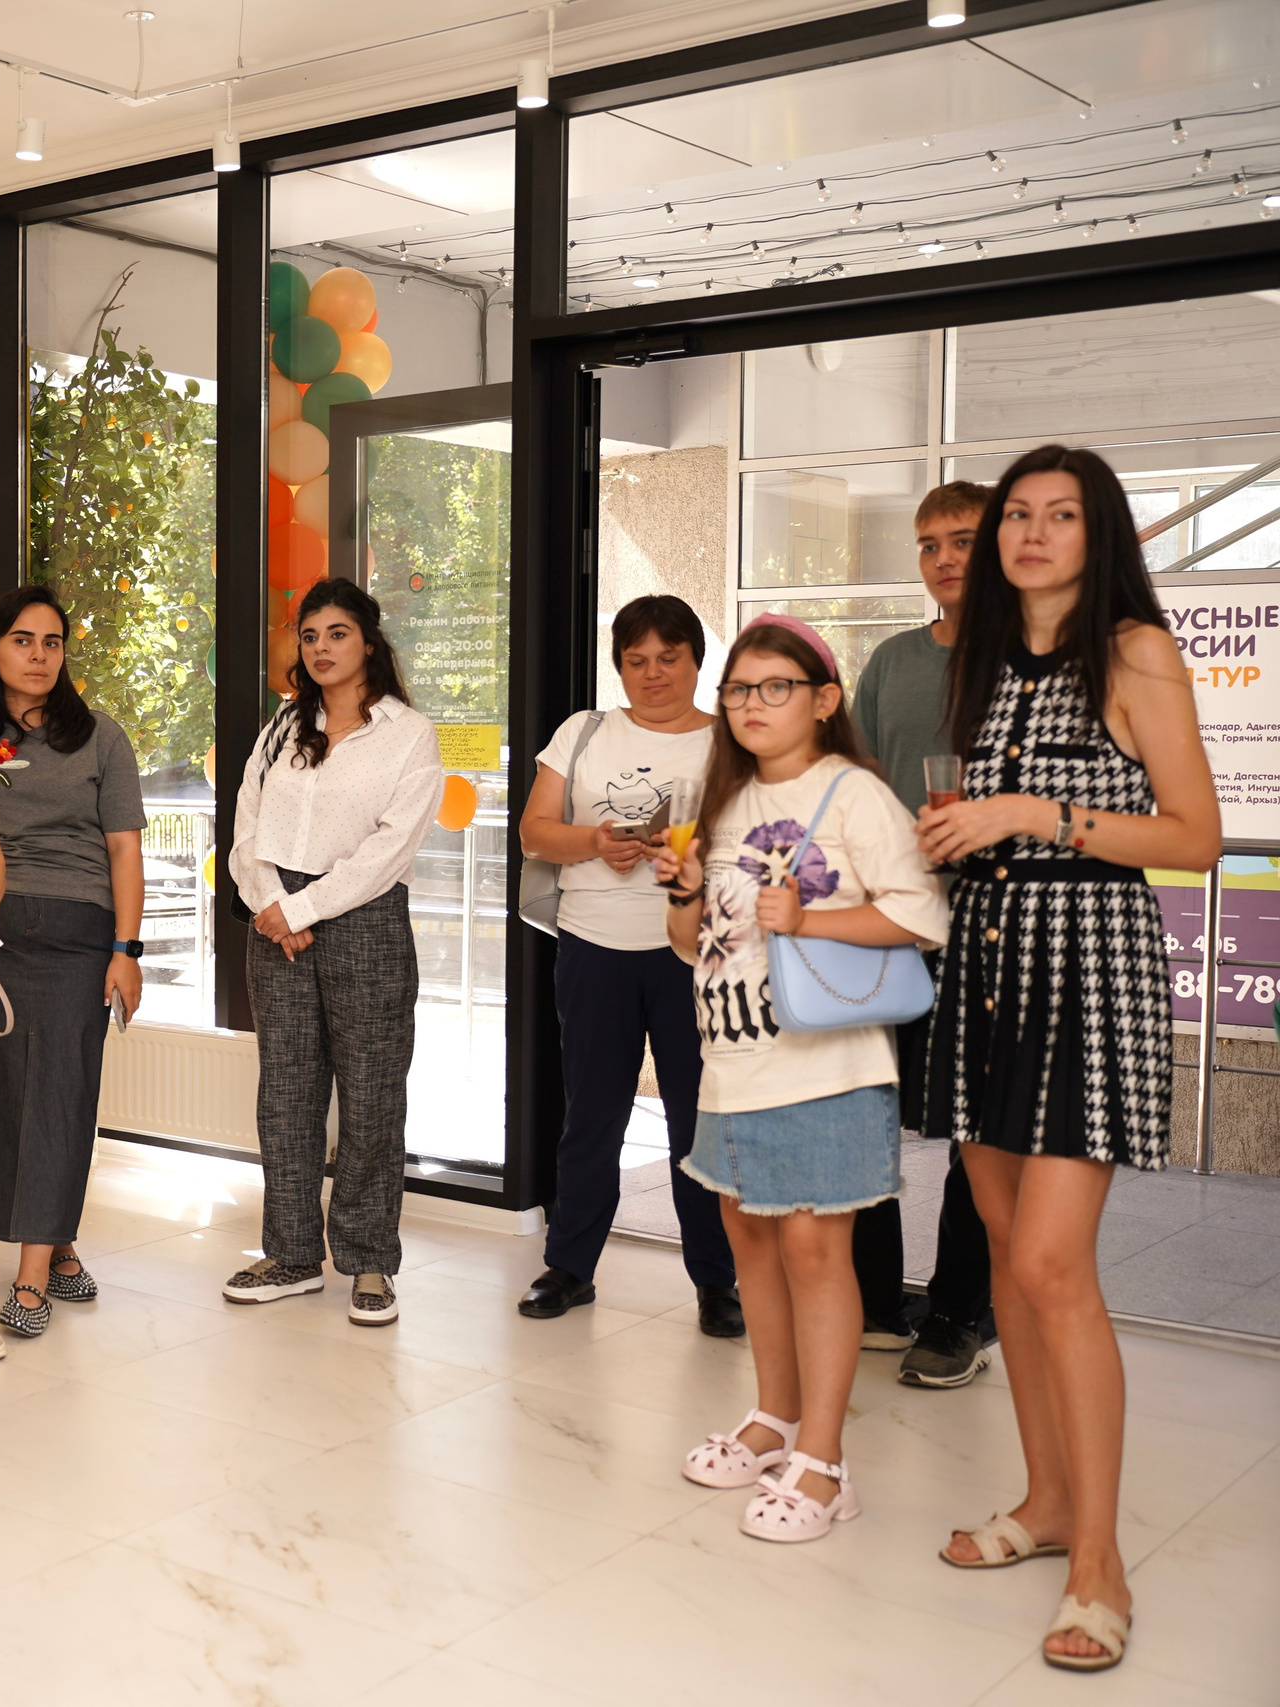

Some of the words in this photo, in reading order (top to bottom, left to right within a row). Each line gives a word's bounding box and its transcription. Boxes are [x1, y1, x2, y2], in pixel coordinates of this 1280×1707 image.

[409, 616, 448, 627] Режим
[414, 640, 493, 653] 08:00-20:00
[1222, 734, 1263, 744] Горячий
[1191, 935, 1237, 954] 4Б
